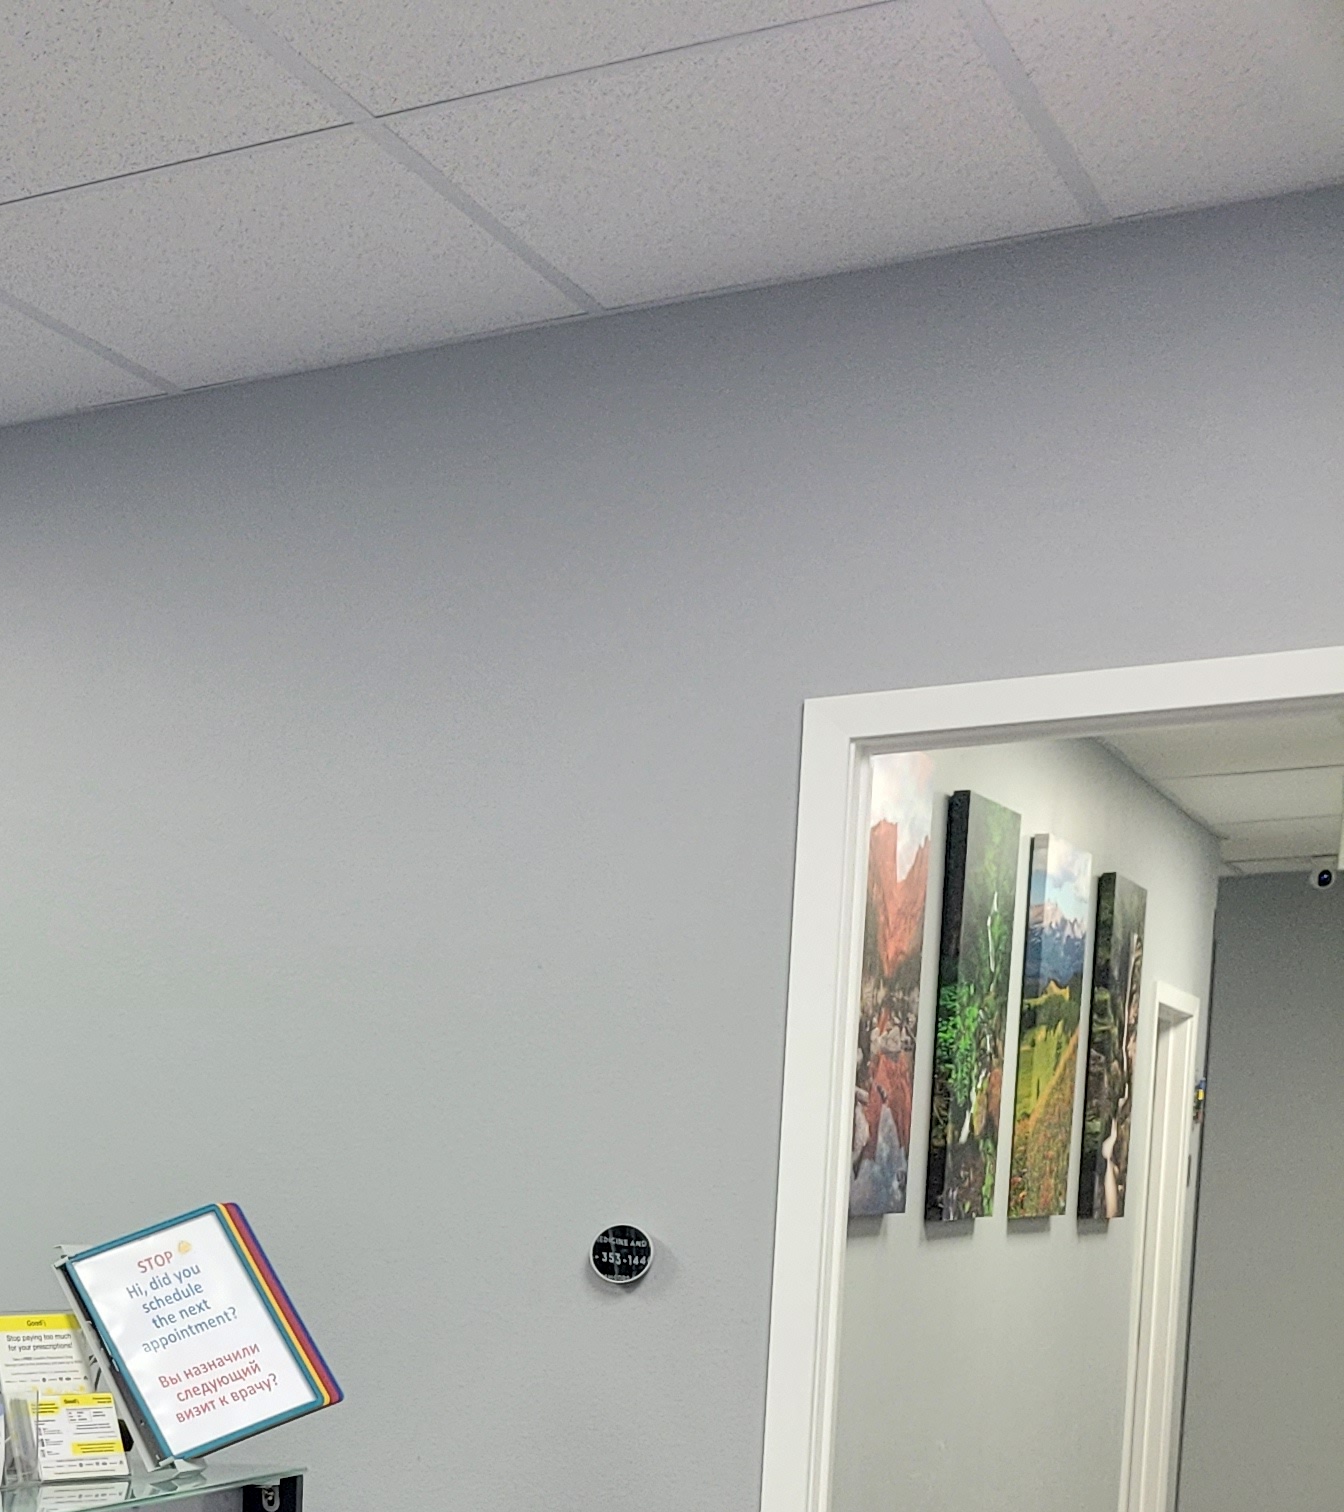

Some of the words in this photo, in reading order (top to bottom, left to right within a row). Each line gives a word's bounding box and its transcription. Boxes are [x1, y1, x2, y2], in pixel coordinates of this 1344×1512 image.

[137, 1251, 173, 1273] STOP
[126, 1282, 148, 1299] Hi,
[149, 1272, 172, 1291] did
[173, 1264, 201, 1283] you
[142, 1283, 204, 1314] schedule
[142, 1306, 238, 1353] appointment?
[152, 1313, 177, 1329] the
[178, 1299, 212, 1320] next
[6, 1334, 22, 1342] Stop
[22, 1335, 43, 1343] paying
[158, 1373, 182, 1388] Вы
[183, 1343, 260, 1380] назначили
[176, 1360, 262, 1402] следующий
[175, 1399, 216, 1423] визит
[218, 1395, 229, 1407] к
[230, 1373, 278, 1402] врачу?
